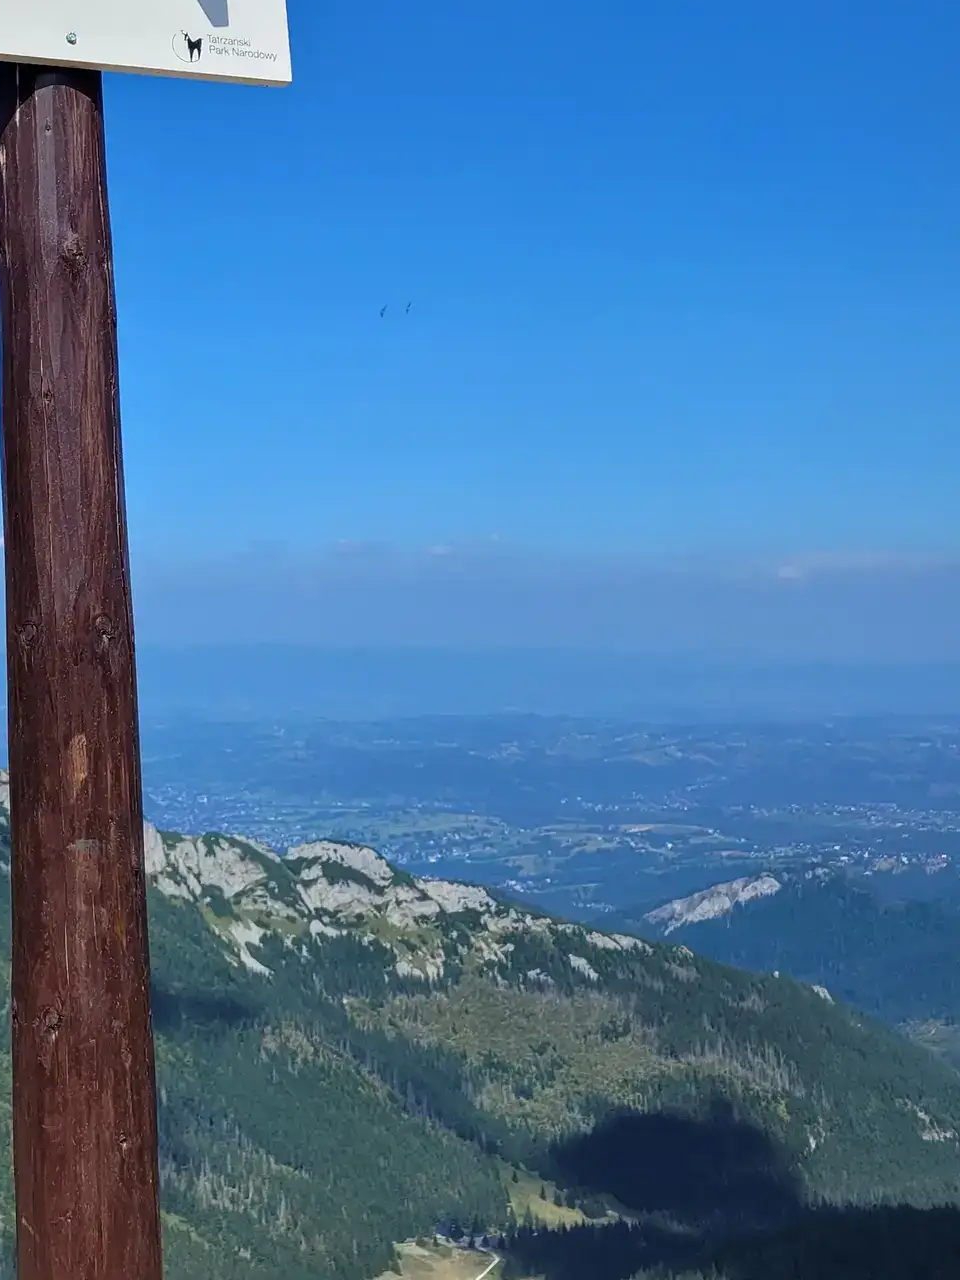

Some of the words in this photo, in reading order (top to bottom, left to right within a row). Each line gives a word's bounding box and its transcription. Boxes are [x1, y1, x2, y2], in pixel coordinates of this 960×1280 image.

[206, 33, 252, 47] Tatrzański
[209, 45, 230, 56] Park
[231, 47, 277, 62] Narodowy
